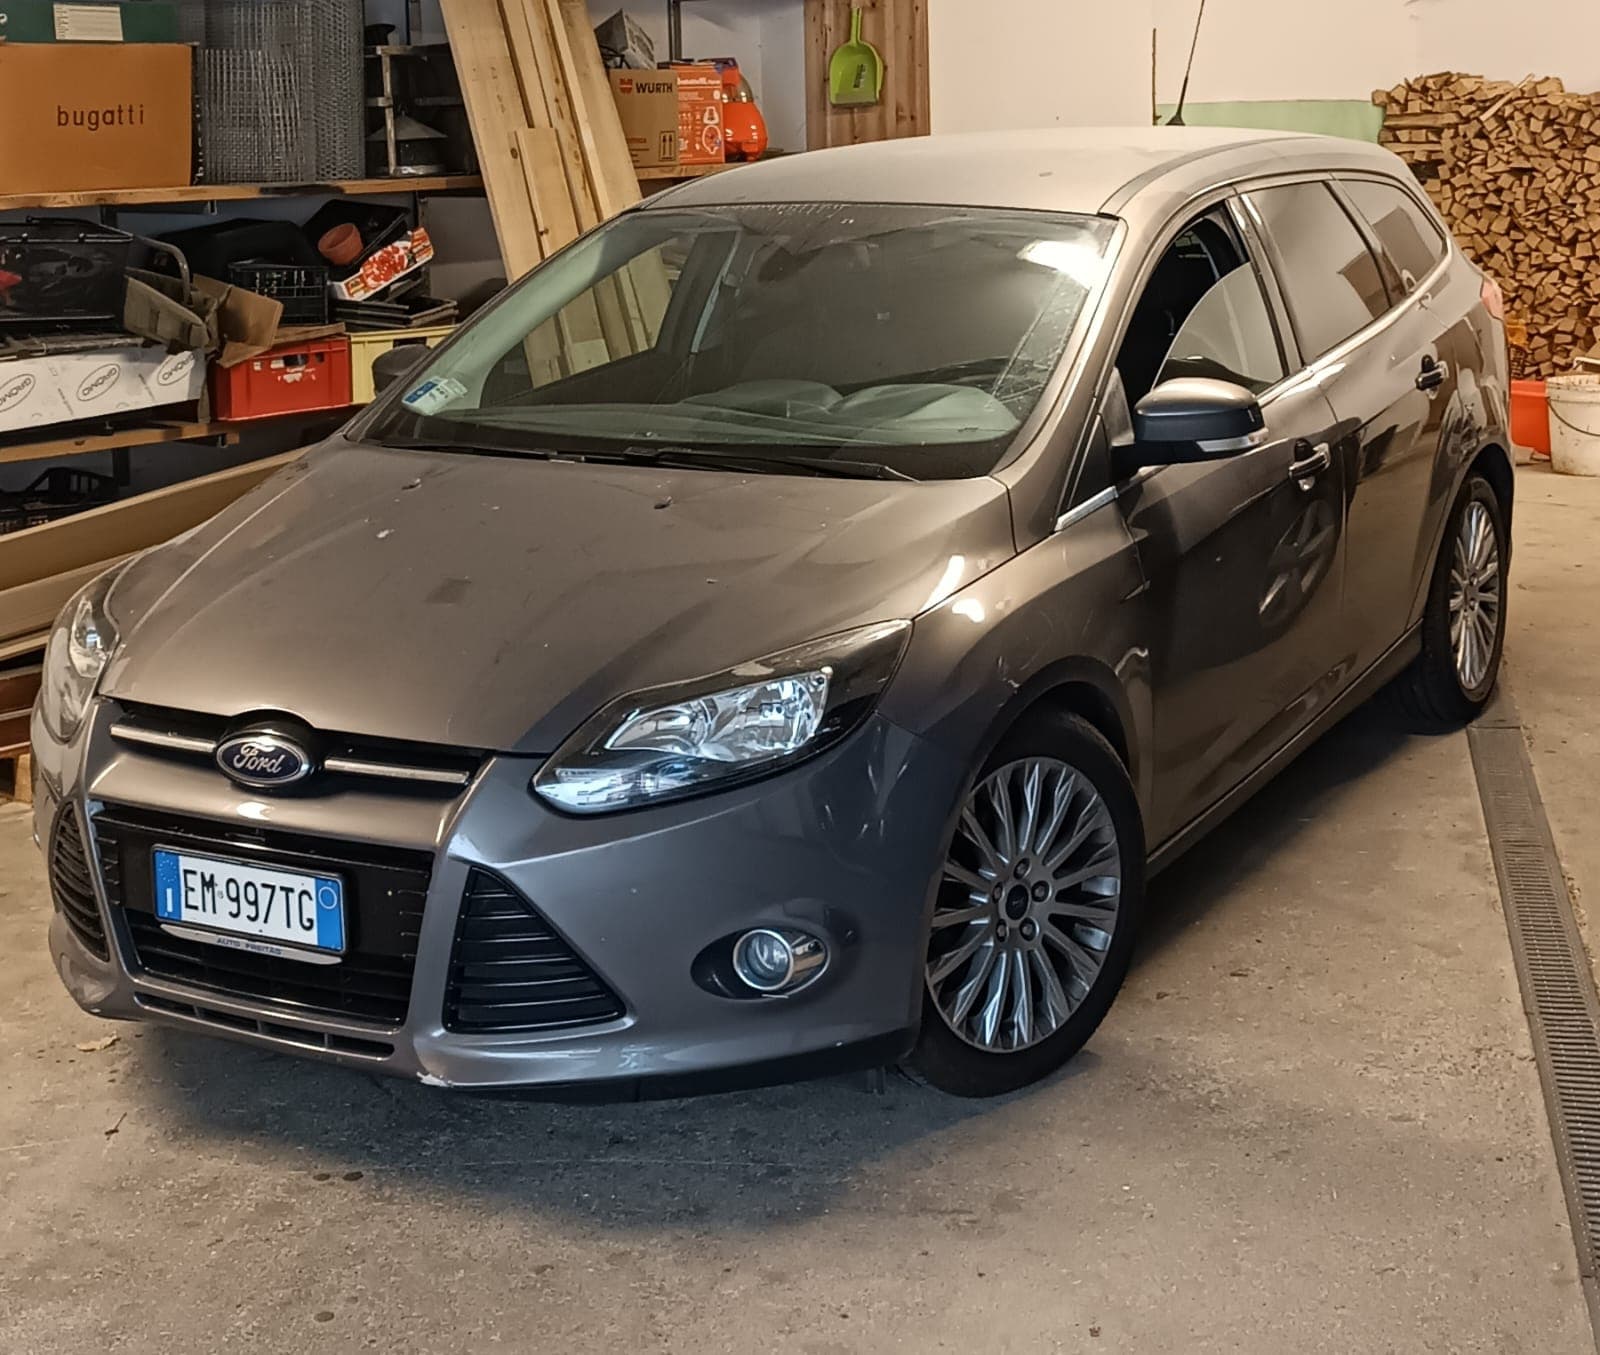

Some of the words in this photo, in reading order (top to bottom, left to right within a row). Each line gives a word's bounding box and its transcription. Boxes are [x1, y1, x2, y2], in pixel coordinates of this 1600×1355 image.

[57, 104, 144, 131] bugatti
[233, 742, 285, 773] Ford
[216, 937, 241, 948] AUTO
